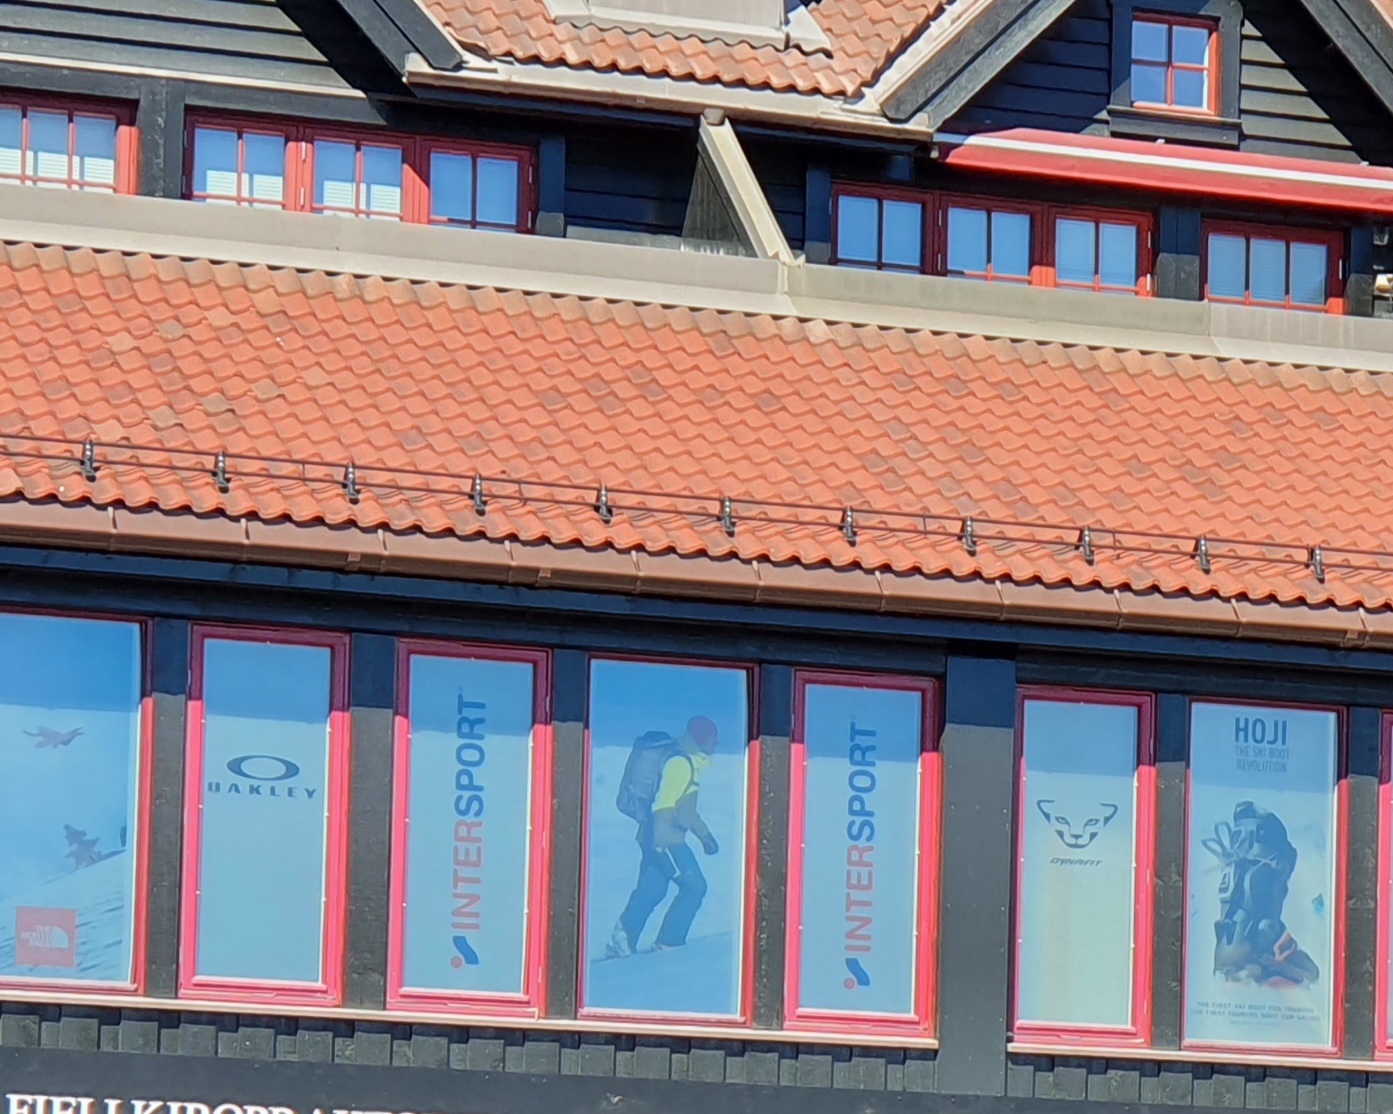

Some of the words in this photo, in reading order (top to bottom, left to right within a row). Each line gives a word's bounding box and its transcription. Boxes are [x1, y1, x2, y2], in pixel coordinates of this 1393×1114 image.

[207, 781, 317, 799] OAKLEY
[1234, 716, 1288, 746] HOJI
[450, 692, 487, 930] INTERSPORT
[843, 720, 878, 953] INTERSPORT
